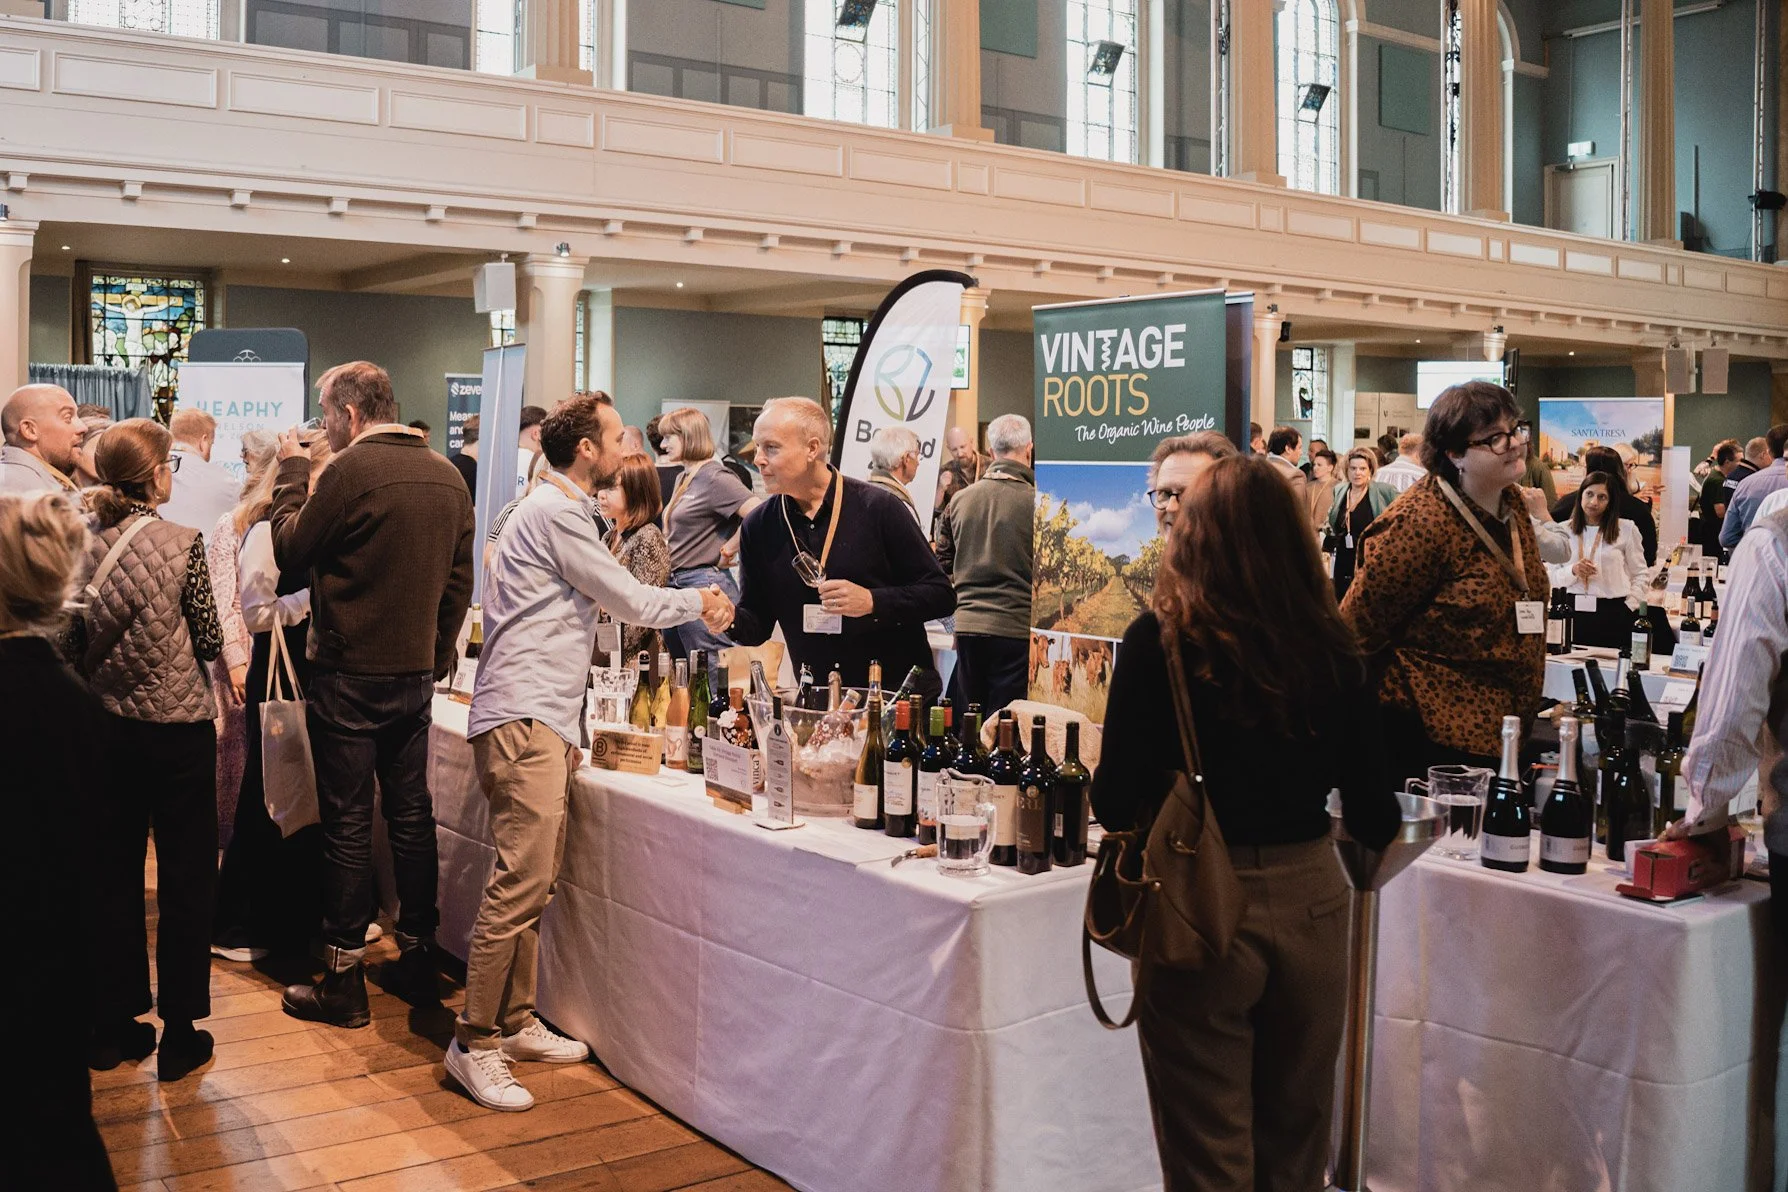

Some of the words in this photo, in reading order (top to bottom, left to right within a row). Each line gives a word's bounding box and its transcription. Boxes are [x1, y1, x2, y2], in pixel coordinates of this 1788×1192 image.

[1040, 323, 1187, 374] VINTAGE
[460, 384, 482, 396] zeve
[1043, 373, 1150, 418] ROOTS
[1075, 424, 1096, 442] The
[1098, 422, 1139, 445] Organic
[1141, 416, 1173, 436] Wine
[1176, 413, 1216, 433] People
[1571, 428, 1599, 438] SANTA
[1600, 428, 1627, 438] TRESA
